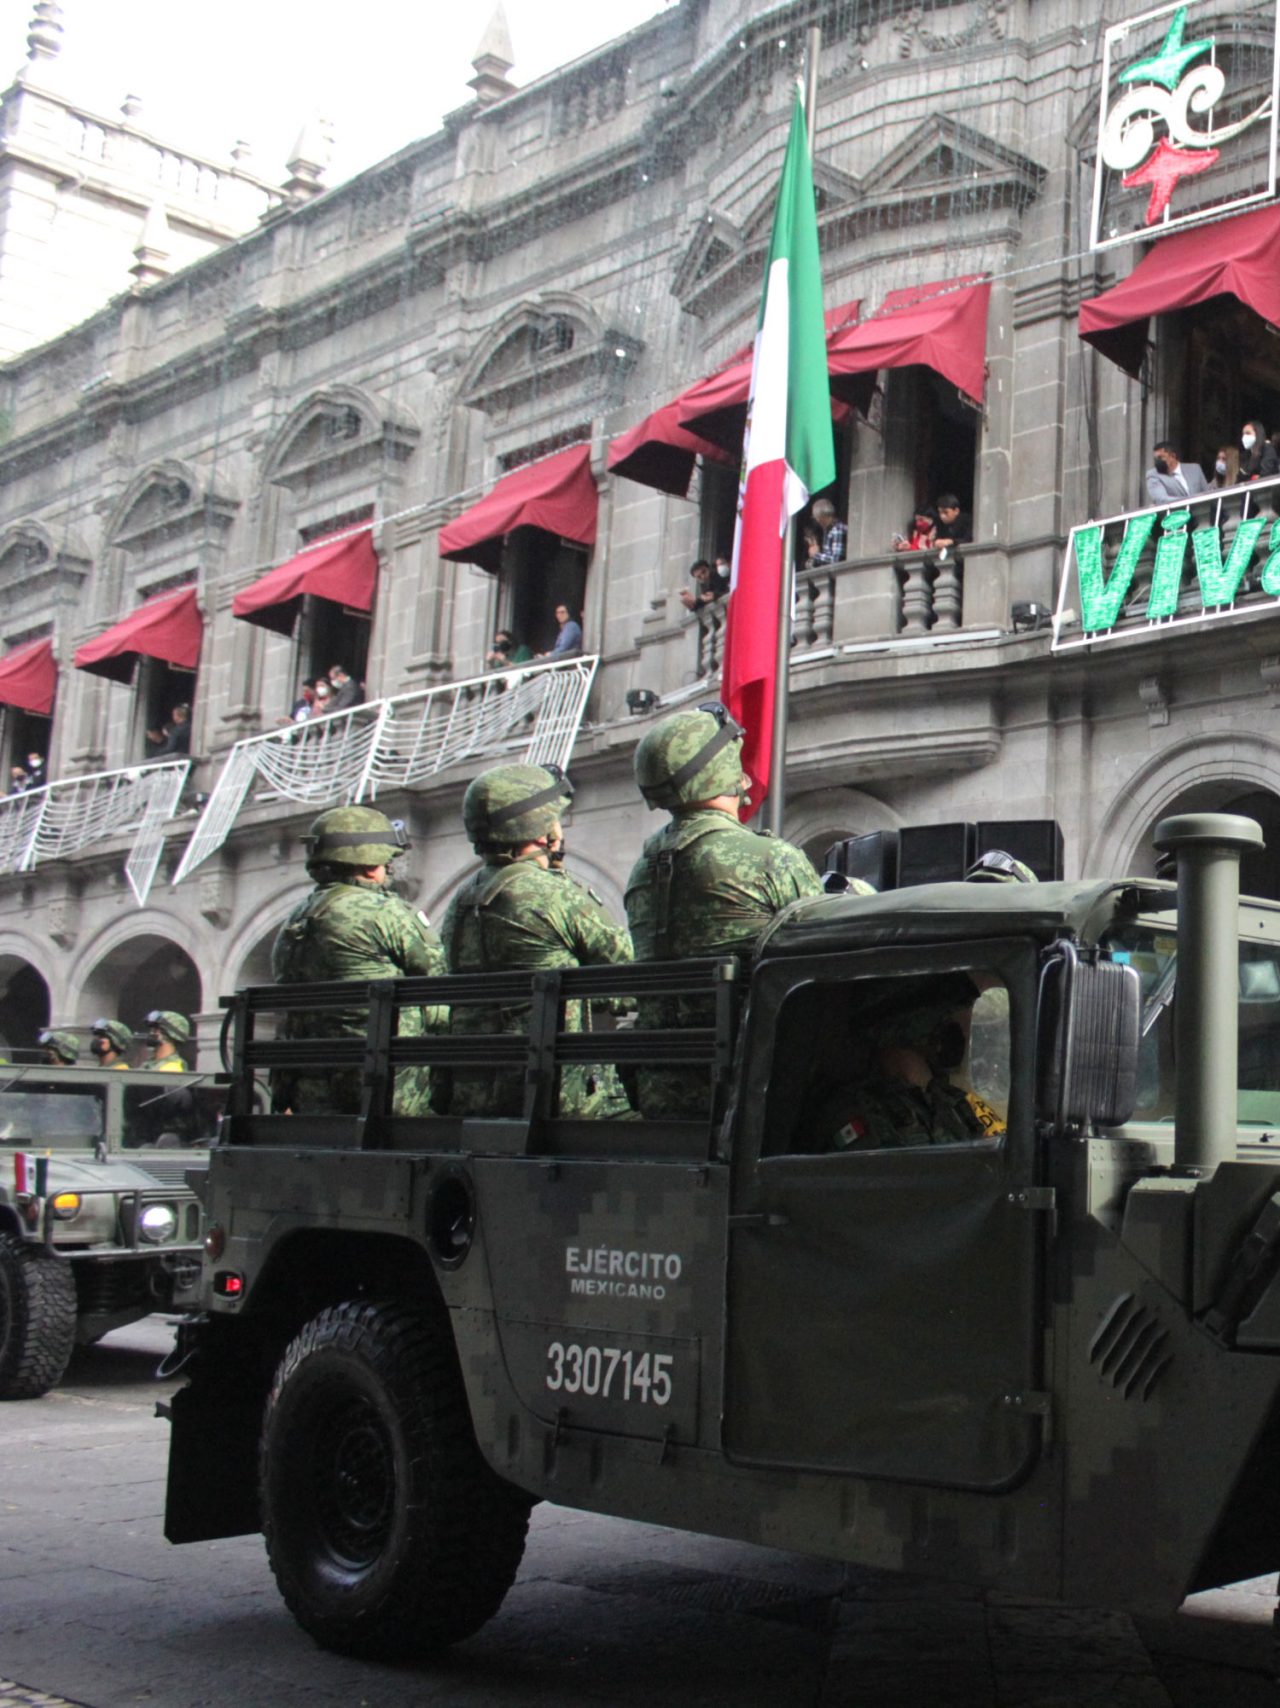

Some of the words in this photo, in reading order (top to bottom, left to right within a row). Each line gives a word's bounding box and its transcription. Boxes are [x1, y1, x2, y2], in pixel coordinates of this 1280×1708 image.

[565, 1244, 682, 1280] EJÉRCITO
[570, 1278, 667, 1300] MEXICANO
[546, 1342, 674, 1405] 3307145
